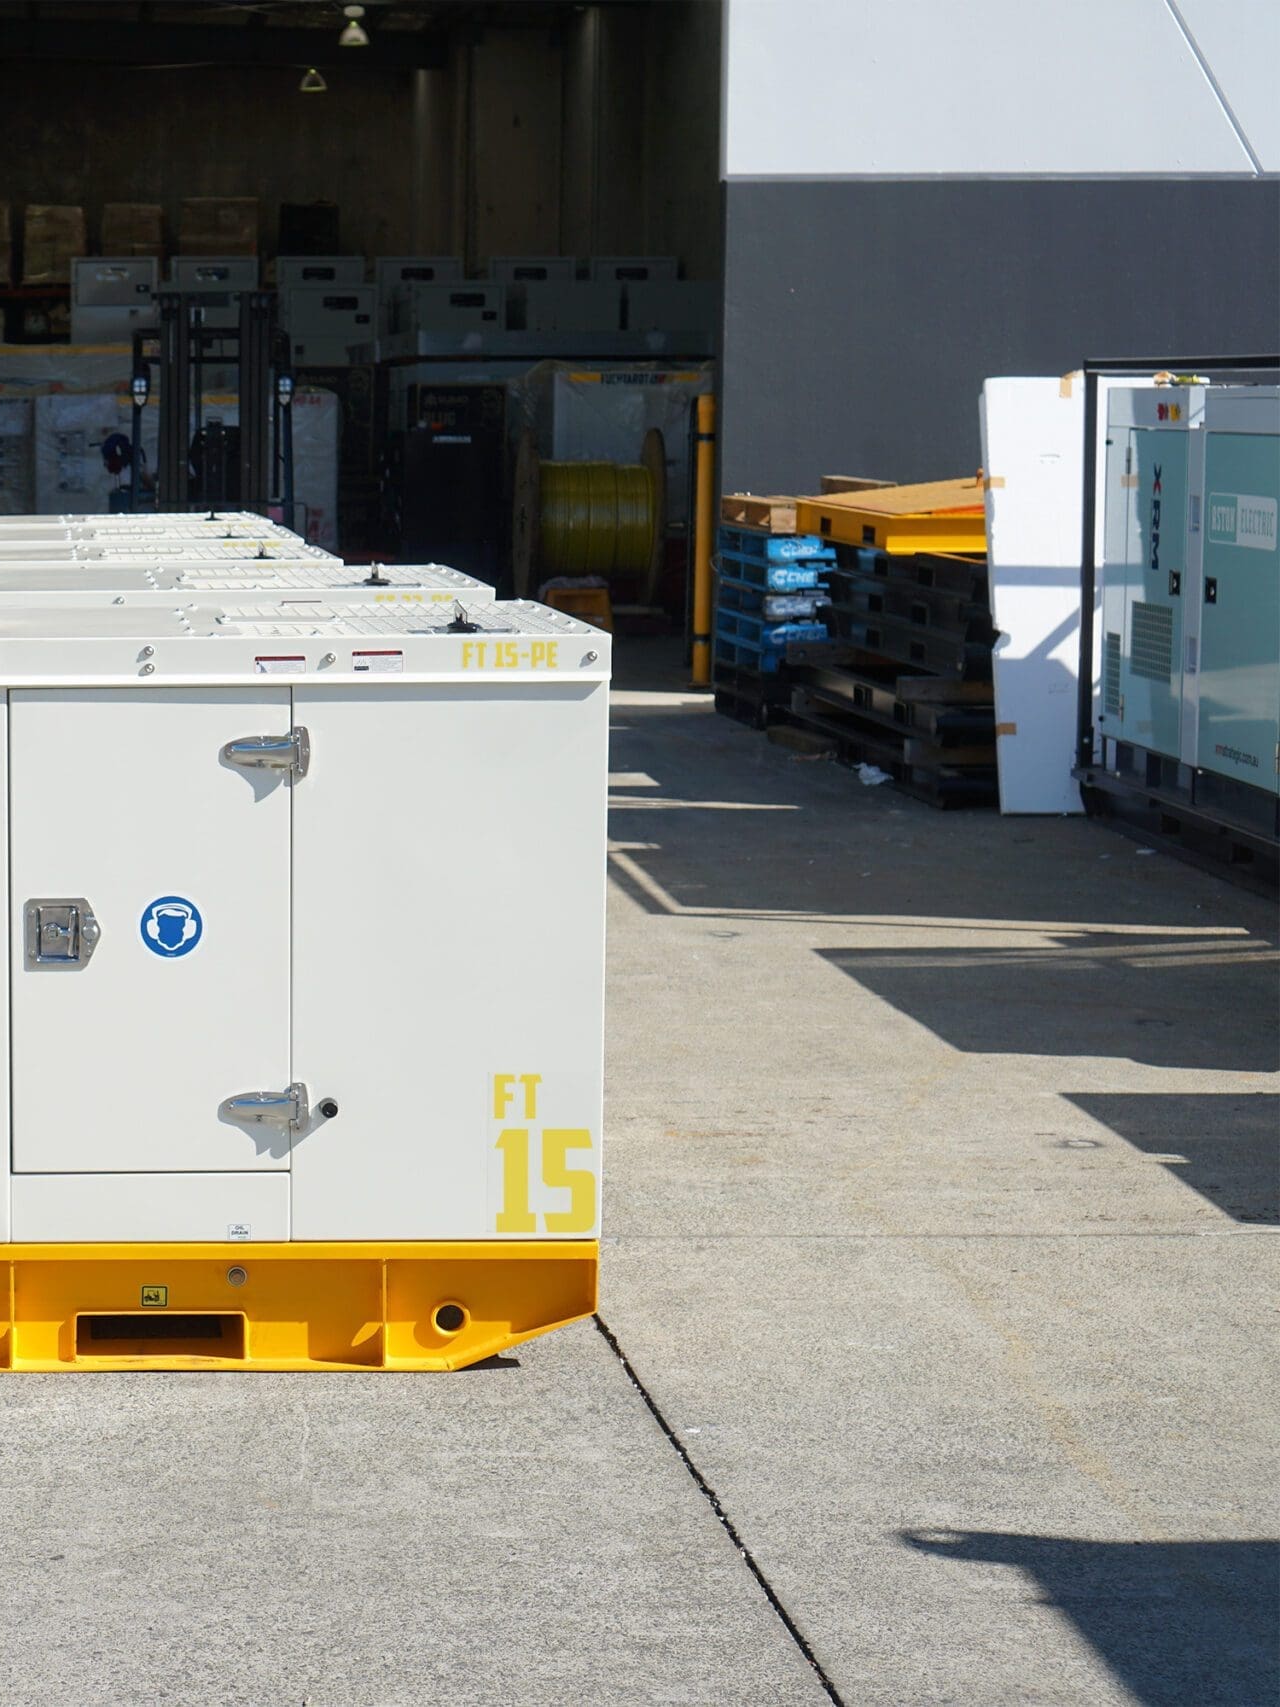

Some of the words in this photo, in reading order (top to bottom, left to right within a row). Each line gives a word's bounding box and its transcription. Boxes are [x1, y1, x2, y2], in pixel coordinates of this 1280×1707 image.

[1240, 507, 1275, 538] ELECTRIC
[461, 642, 487, 668] FT
[494, 642, 558, 668] 15-PE
[494, 1074, 542, 1119] FT
[495, 1129, 596, 1233] 15
